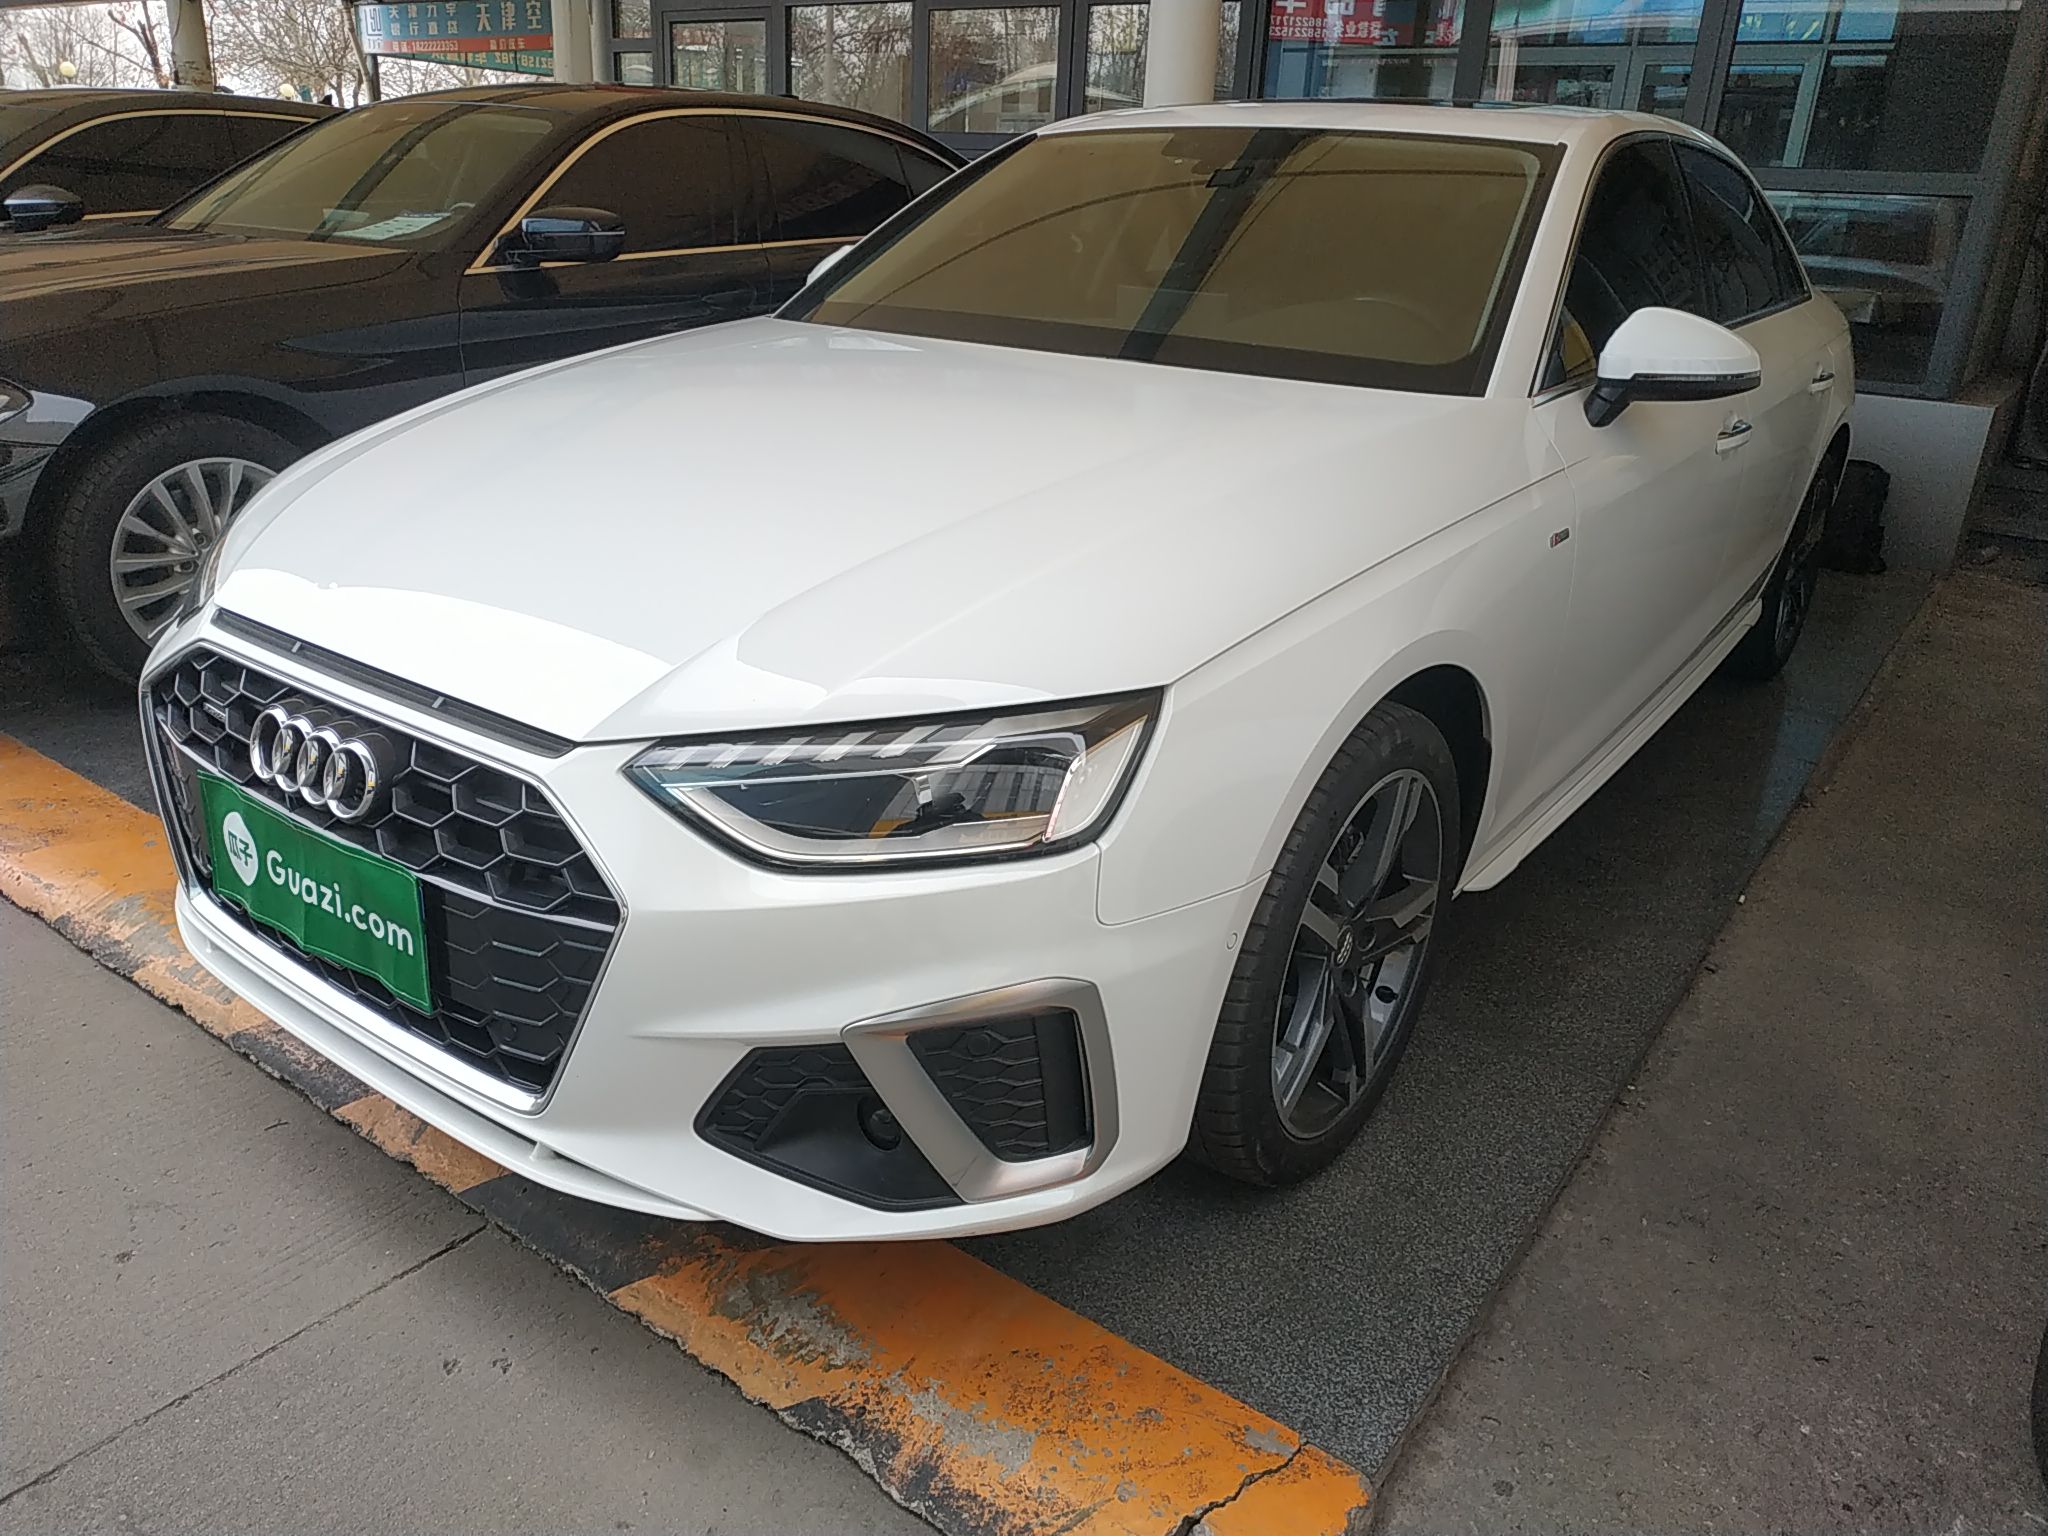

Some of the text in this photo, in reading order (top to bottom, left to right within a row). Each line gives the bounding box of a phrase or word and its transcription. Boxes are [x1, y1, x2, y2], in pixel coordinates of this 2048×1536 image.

[476, 1, 542, 31] 天津空
[227, 826, 253, 867] 瓜子
[266, 850, 414, 956] Guazi.com
